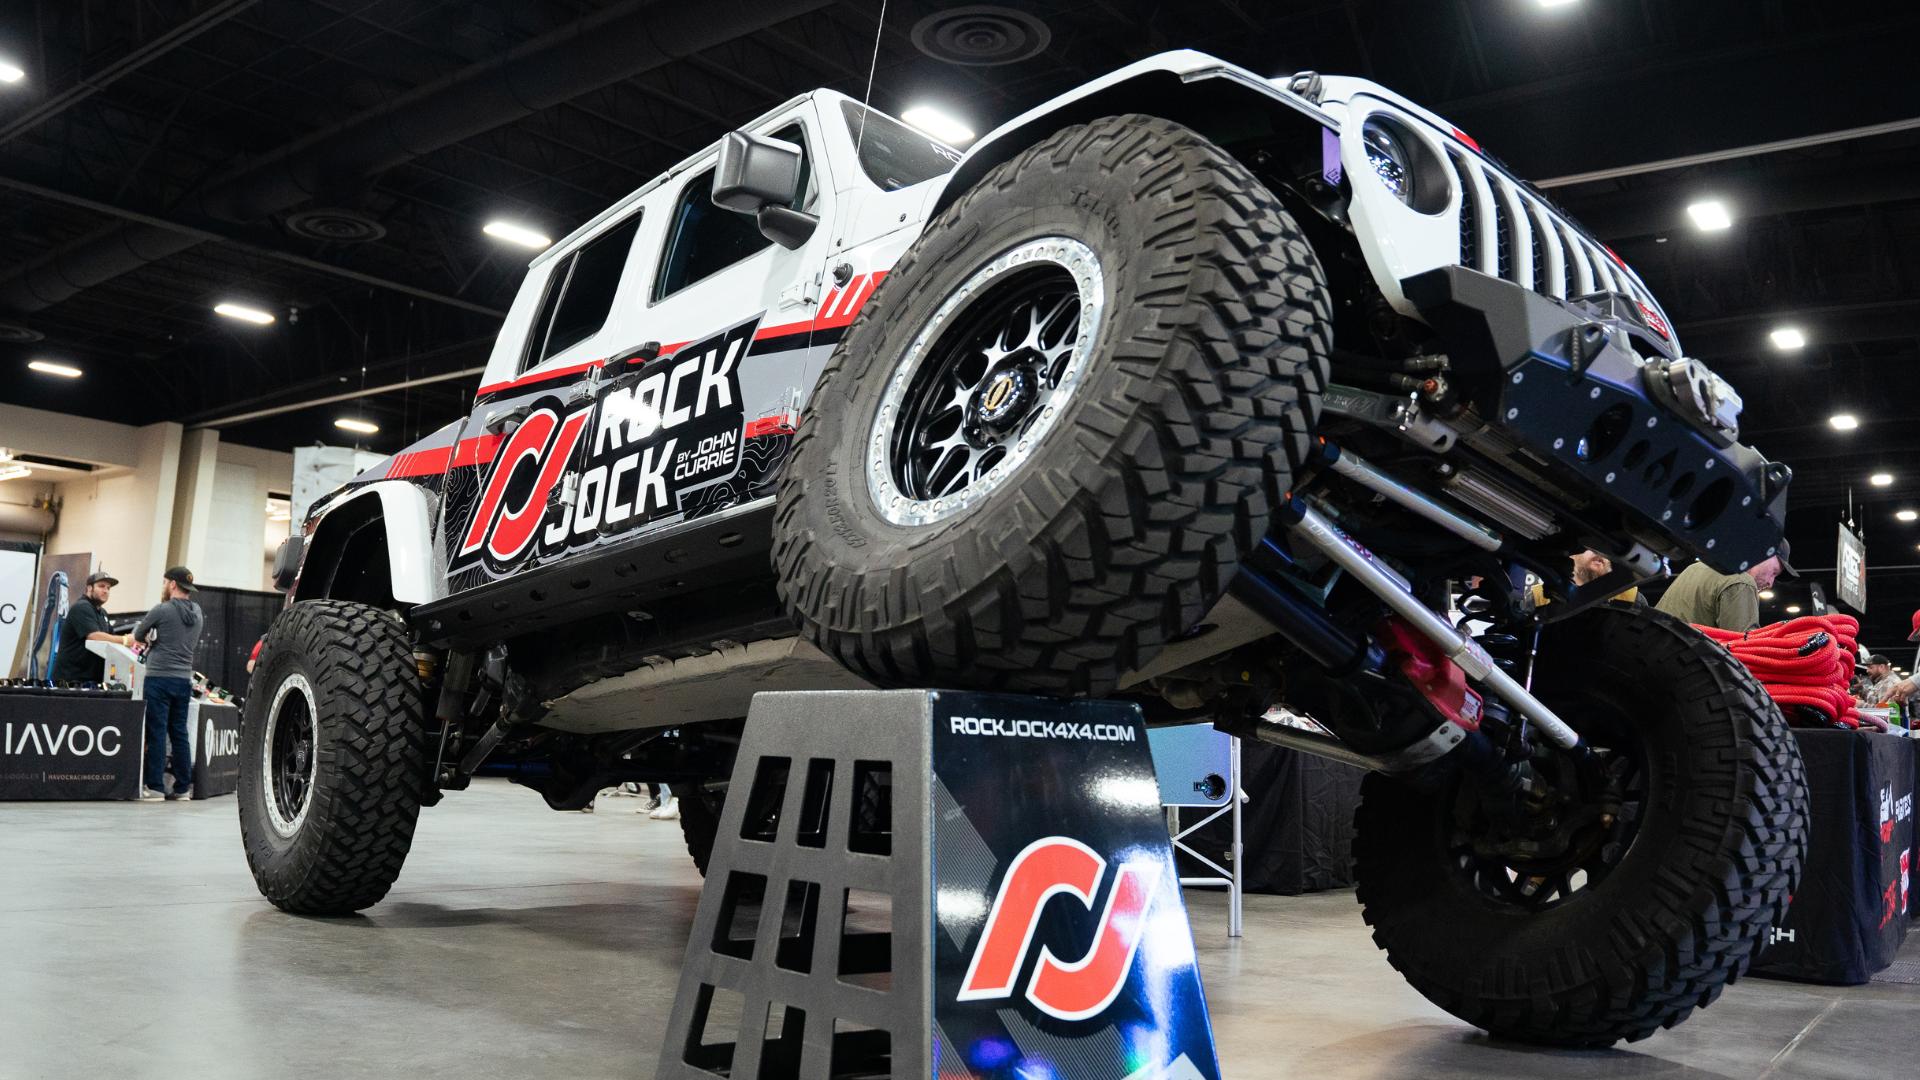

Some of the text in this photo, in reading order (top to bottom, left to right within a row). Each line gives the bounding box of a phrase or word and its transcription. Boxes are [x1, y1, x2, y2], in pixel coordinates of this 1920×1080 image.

[593, 337, 744, 458] ROCK
[674, 446, 735, 481] CURRIE
[677, 428, 738, 464] BY JOHN
[544, 437, 679, 546] JOCK
[950, 716, 1136, 742] ROCKJOCK4X4.COM
